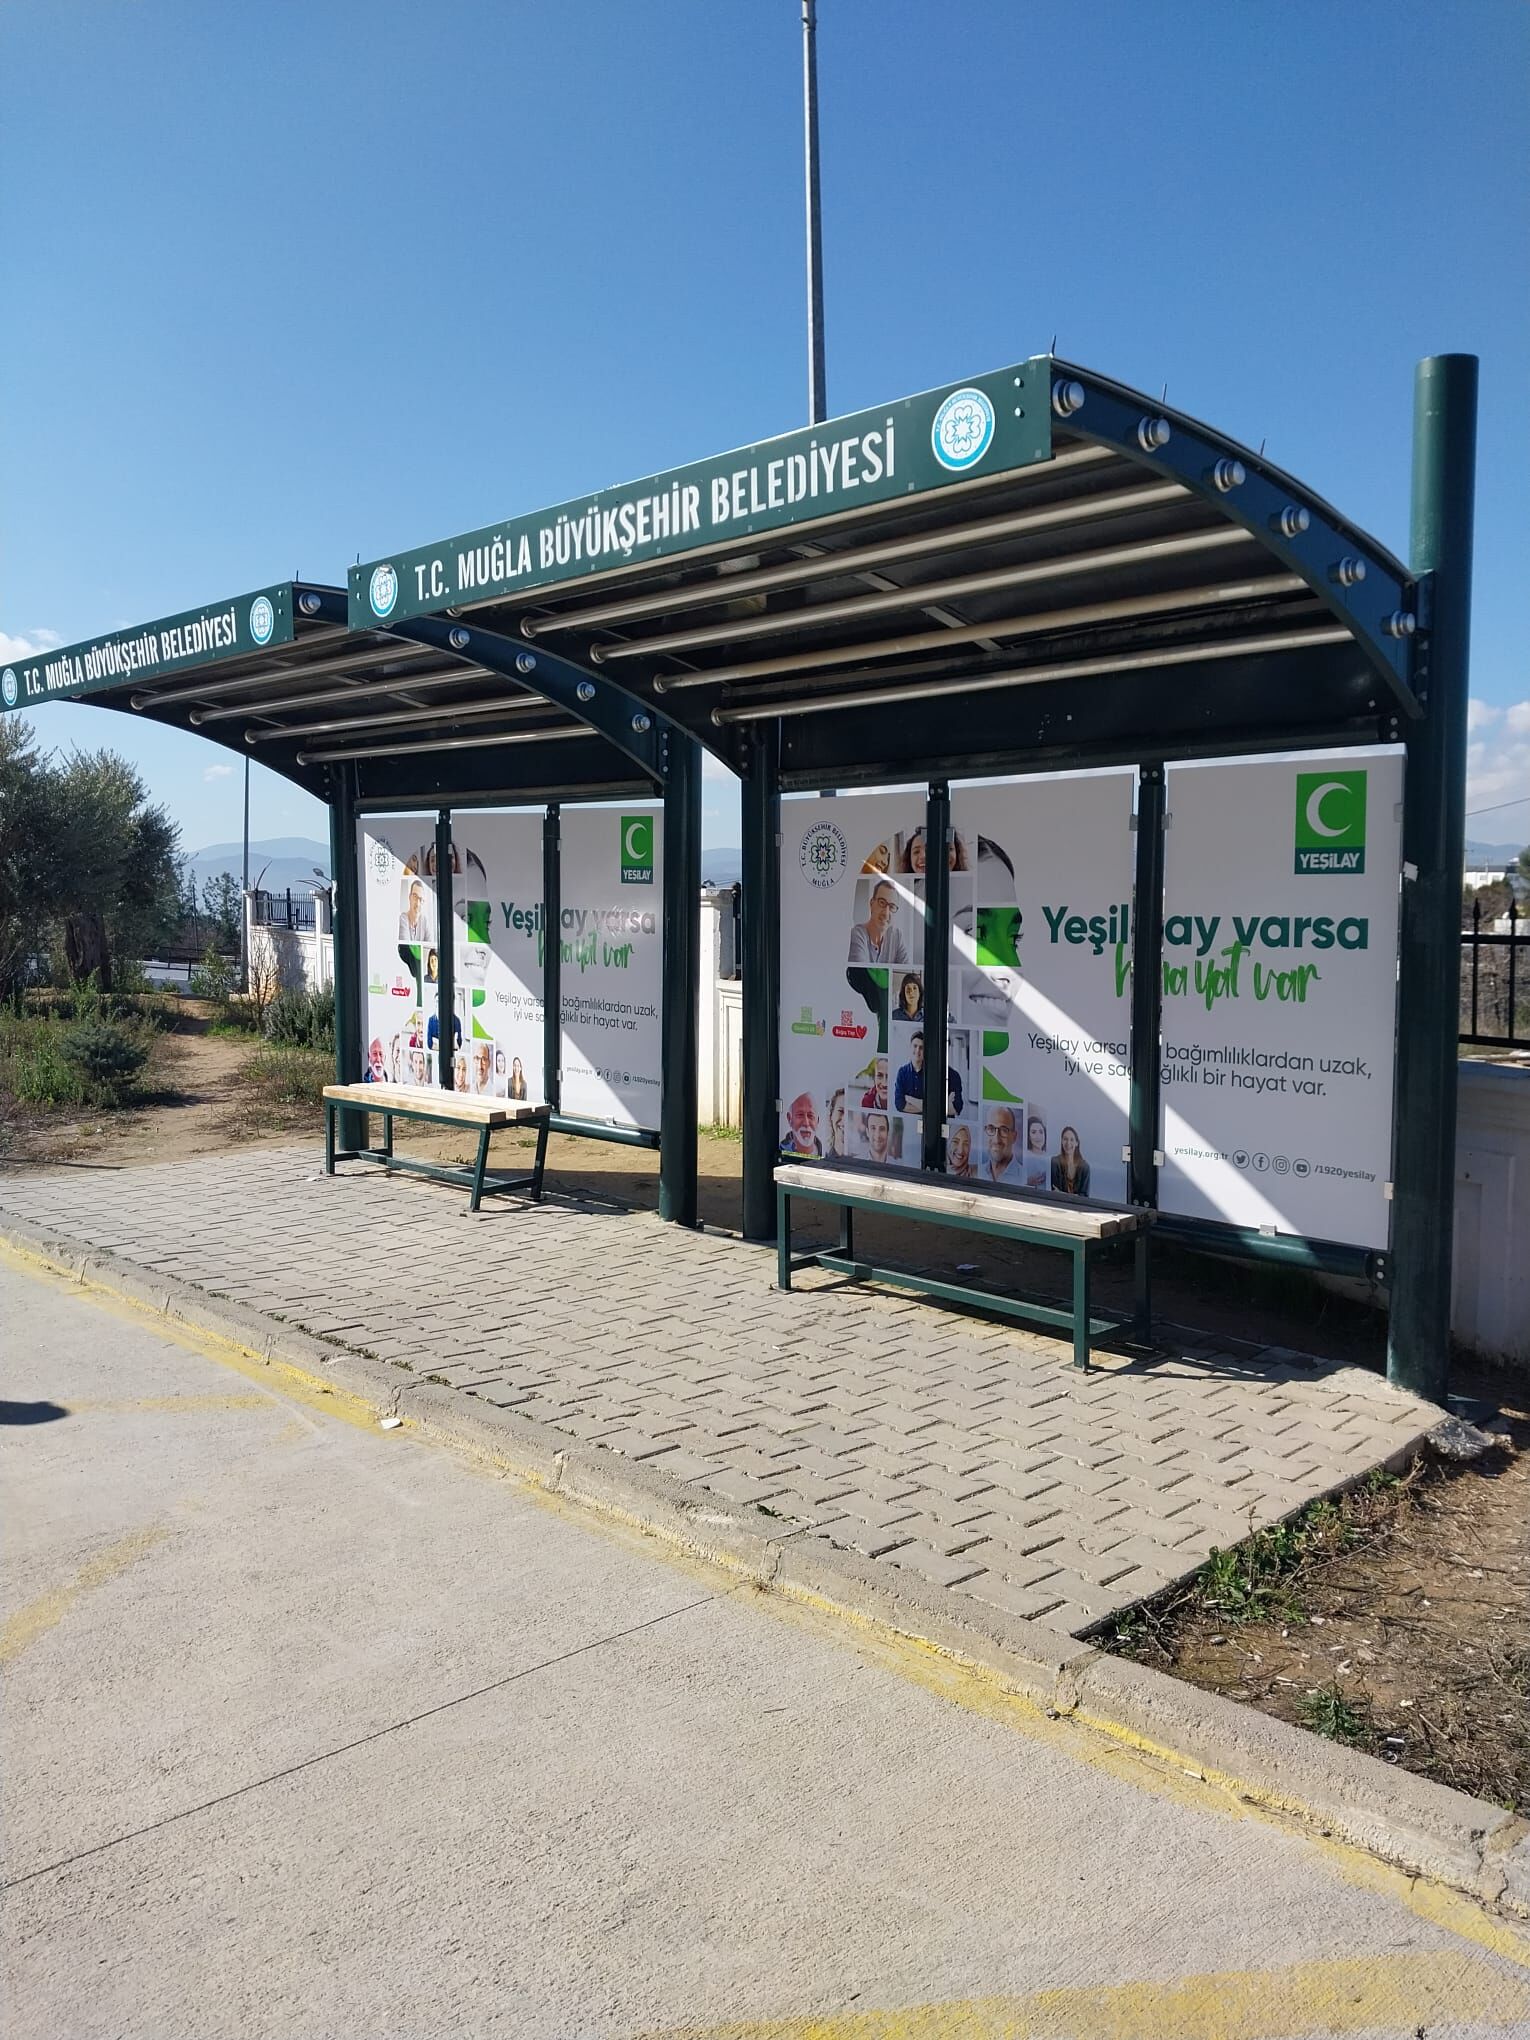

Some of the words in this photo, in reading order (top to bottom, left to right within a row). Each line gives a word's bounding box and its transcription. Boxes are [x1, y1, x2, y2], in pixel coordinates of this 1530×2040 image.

[414, 562, 450, 601] T.C.
[457, 535, 532, 589] MUĞLA
[539, 483, 700, 567] BÜYÜKŞEHİR
[711, 418, 895, 524] BELEDİYESİ
[23, 669, 45, 696] T.C.
[45, 656, 85, 691] MUĞLA
[85, 632, 158, 677] BÜYÜKŞEHİR
[161, 607, 237, 661] BELEDİYESİ
[1299, 852, 1361, 870] YEŞİLAY
[593, 908, 656, 934] varsa
[1232, 916, 1370, 950] varsa
[603, 942, 635, 968] var
[1254, 961, 1322, 1002] var
[495, 992, 522, 1007] Yeşilay
[523, 997, 545, 1008] varsa
[562, 995, 632, 1014] bağımlılıklardan
[634, 1004, 659, 1020] uzak,
[513, 1007, 522, 1022] iyi
[525, 1011, 534, 1021] ve
[580, 1012, 591, 1025] bir
[593, 1014, 620, 1030] hayat
[621, 1020, 638, 1032] var.
[1027, 1033, 1080, 1054] Yeşilay
[1083, 1040, 1128, 1056] varsa
[1165, 1043, 1314, 1071] bağımlılıklardan
[1319, 1058, 1373, 1080] uzak,
[1064, 1056, 1080, 1076] iyi
[1084, 1061, 1103, 1075] ve
[1203, 1067, 1226, 1086] bir
[1231, 1073, 1287, 1093] hayat
[1292, 1079, 1327, 1097] var.
[1174, 1145, 1229, 1161] yesilay.org.tr
[1314, 1164, 1377, 1183] /1920yesilay
